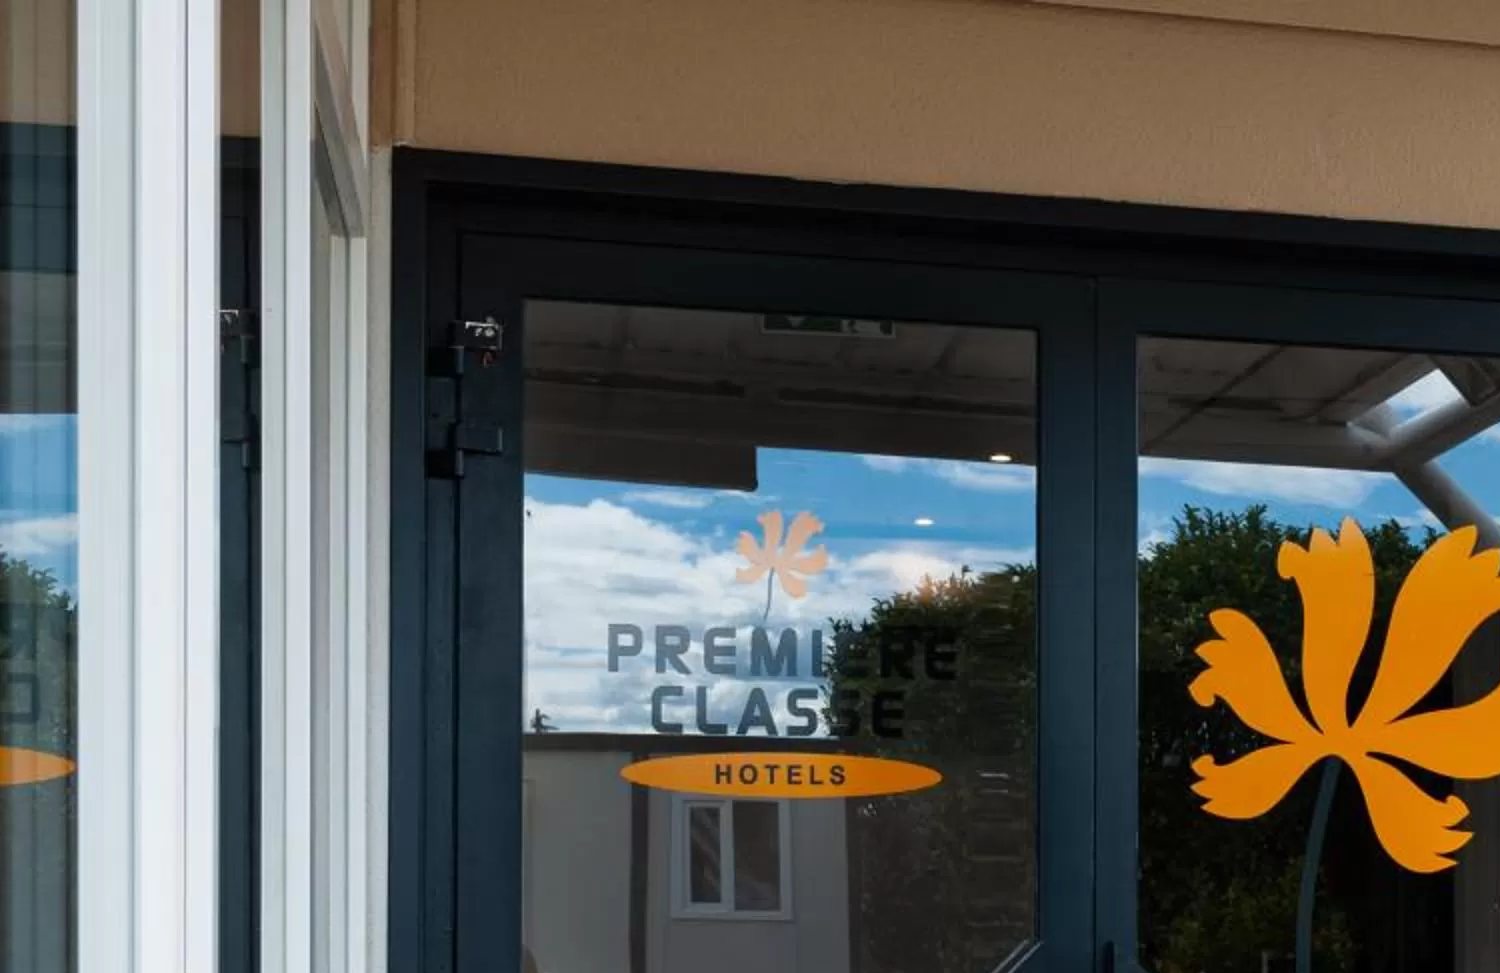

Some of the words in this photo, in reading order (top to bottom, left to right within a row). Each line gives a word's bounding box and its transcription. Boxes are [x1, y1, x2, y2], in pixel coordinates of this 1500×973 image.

[607, 622, 960, 682] PREMIERE
[650, 685, 905, 739] CLASSE
[713, 764, 847, 786] HOTELS
